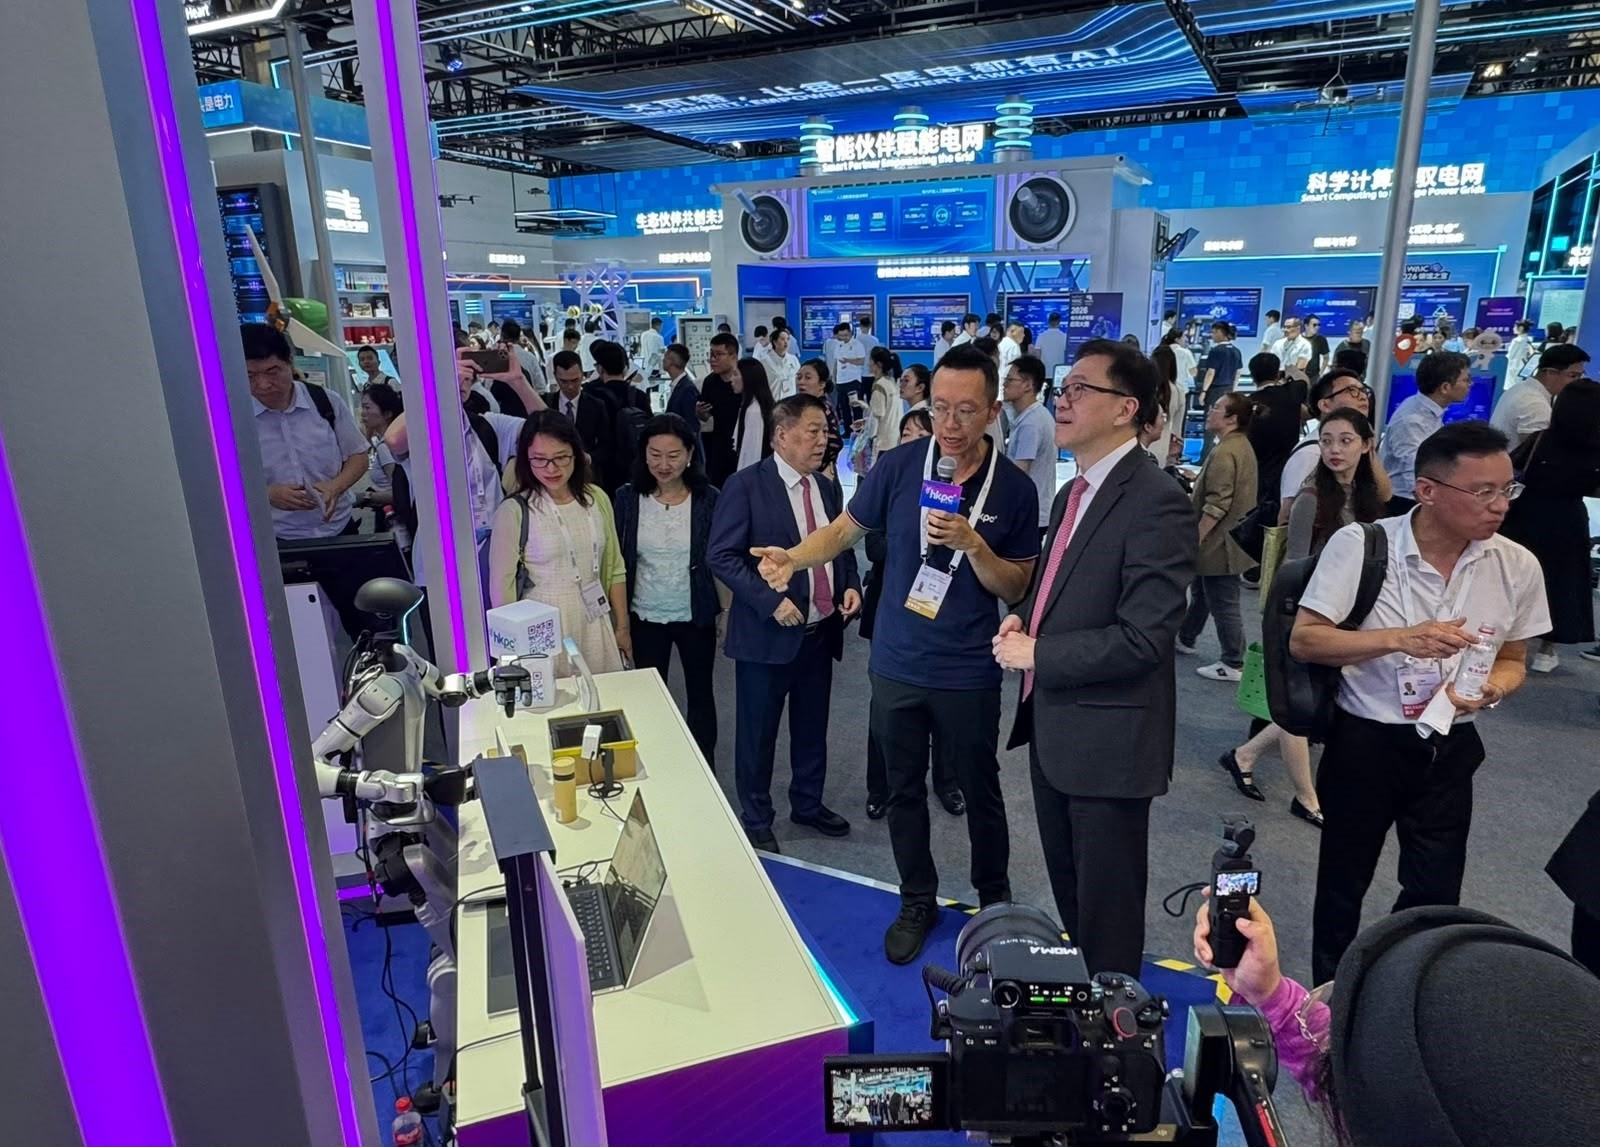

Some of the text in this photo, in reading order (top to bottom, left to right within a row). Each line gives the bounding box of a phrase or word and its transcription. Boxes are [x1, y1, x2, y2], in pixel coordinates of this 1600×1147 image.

[185, 4, 210, 20] Heart
[893, 76, 963, 91] EVERY
[968, 68, 1028, 81] KWH
[1032, 60, 1092, 74] WITH
[1307, 163, 1485, 194] 科学计算驭电网
[1407, 265, 1429, 273] WAIC
[1071, 306, 1088, 314] 2026
[930, 489, 954, 503] hkpc
[493, 631, 515, 649] hkpc
[1029, 946, 1078, 955] MOMA
